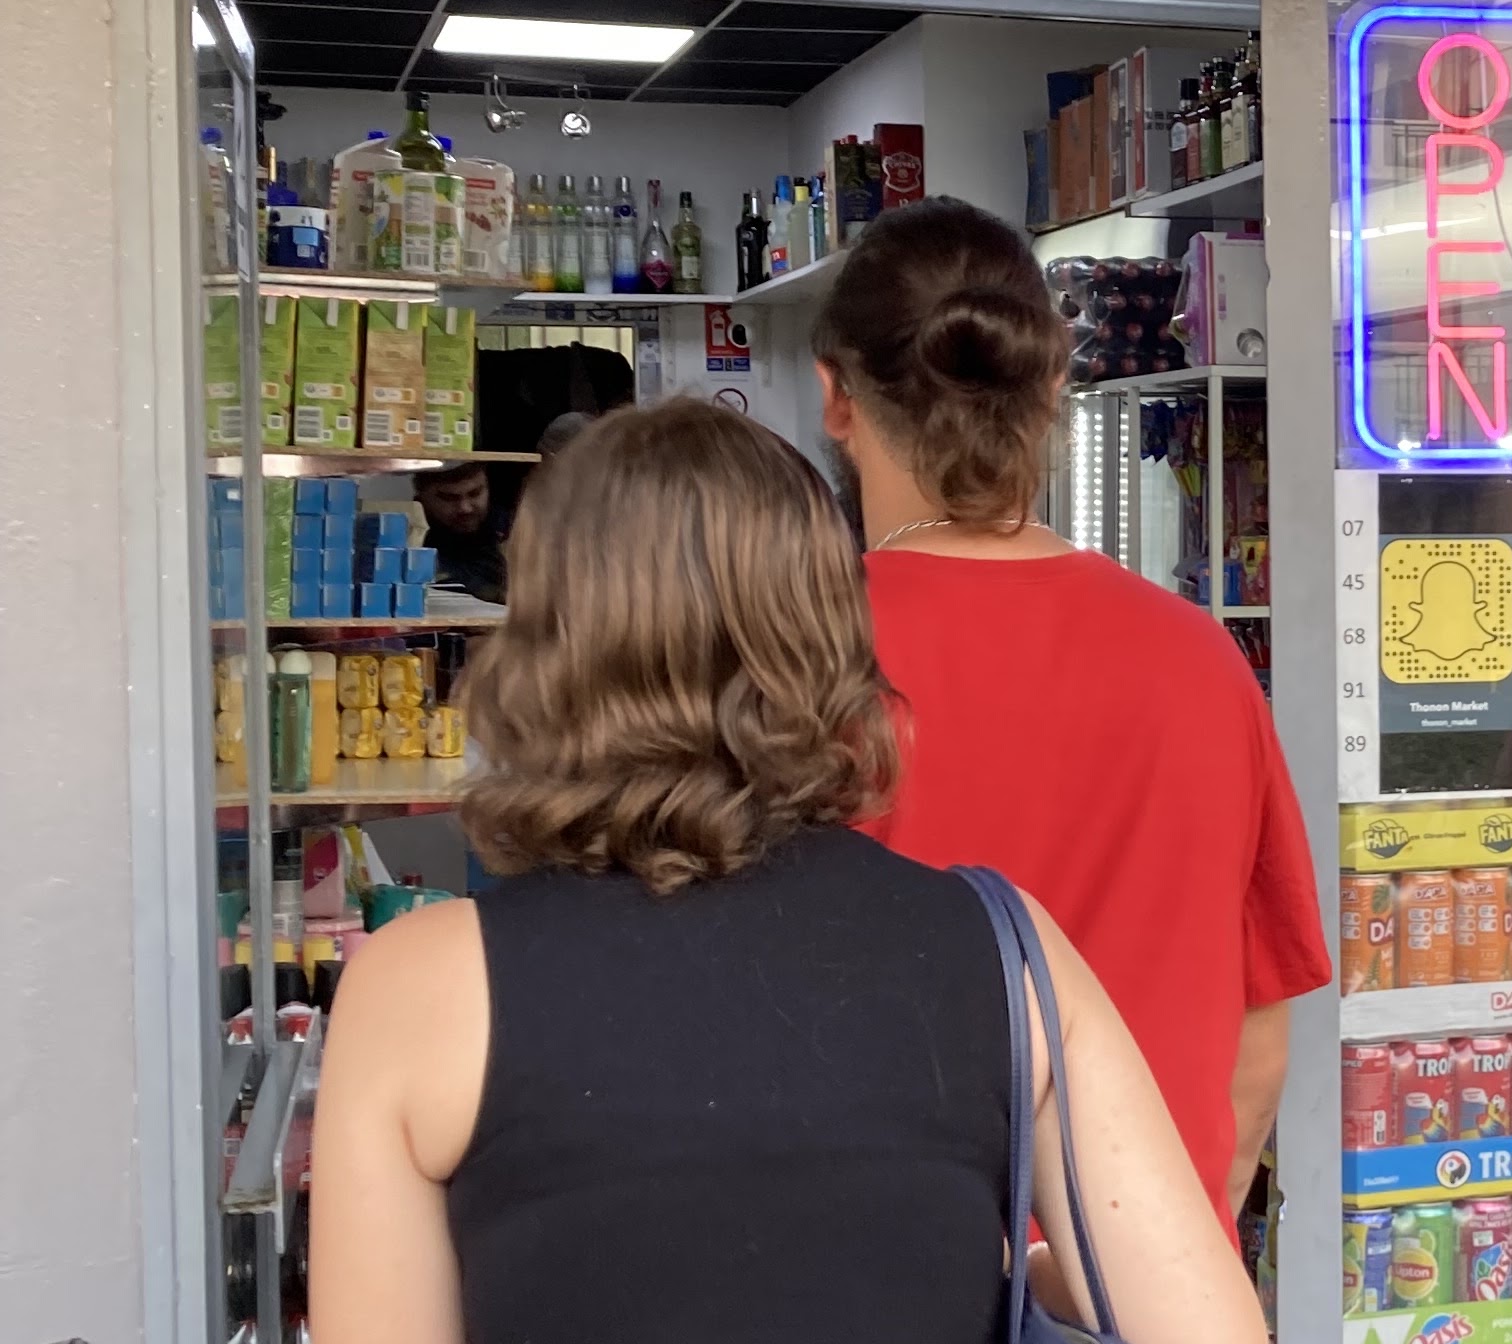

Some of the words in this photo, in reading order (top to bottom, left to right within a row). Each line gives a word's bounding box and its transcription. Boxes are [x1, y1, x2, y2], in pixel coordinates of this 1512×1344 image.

[1418, 32, 1510, 440] OPEN
[1342, 520, 1364, 536] 07
[1342, 574, 1365, 590] 45
[1343, 628, 1366, 644] 68
[1343, 682, 1366, 698] 91
[1409, 702, 1449, 713] Thonon
[1451, 700, 1489, 712] Market
[1344, 735, 1367, 752] 89
[1363, 825, 1409, 852] FANTA
